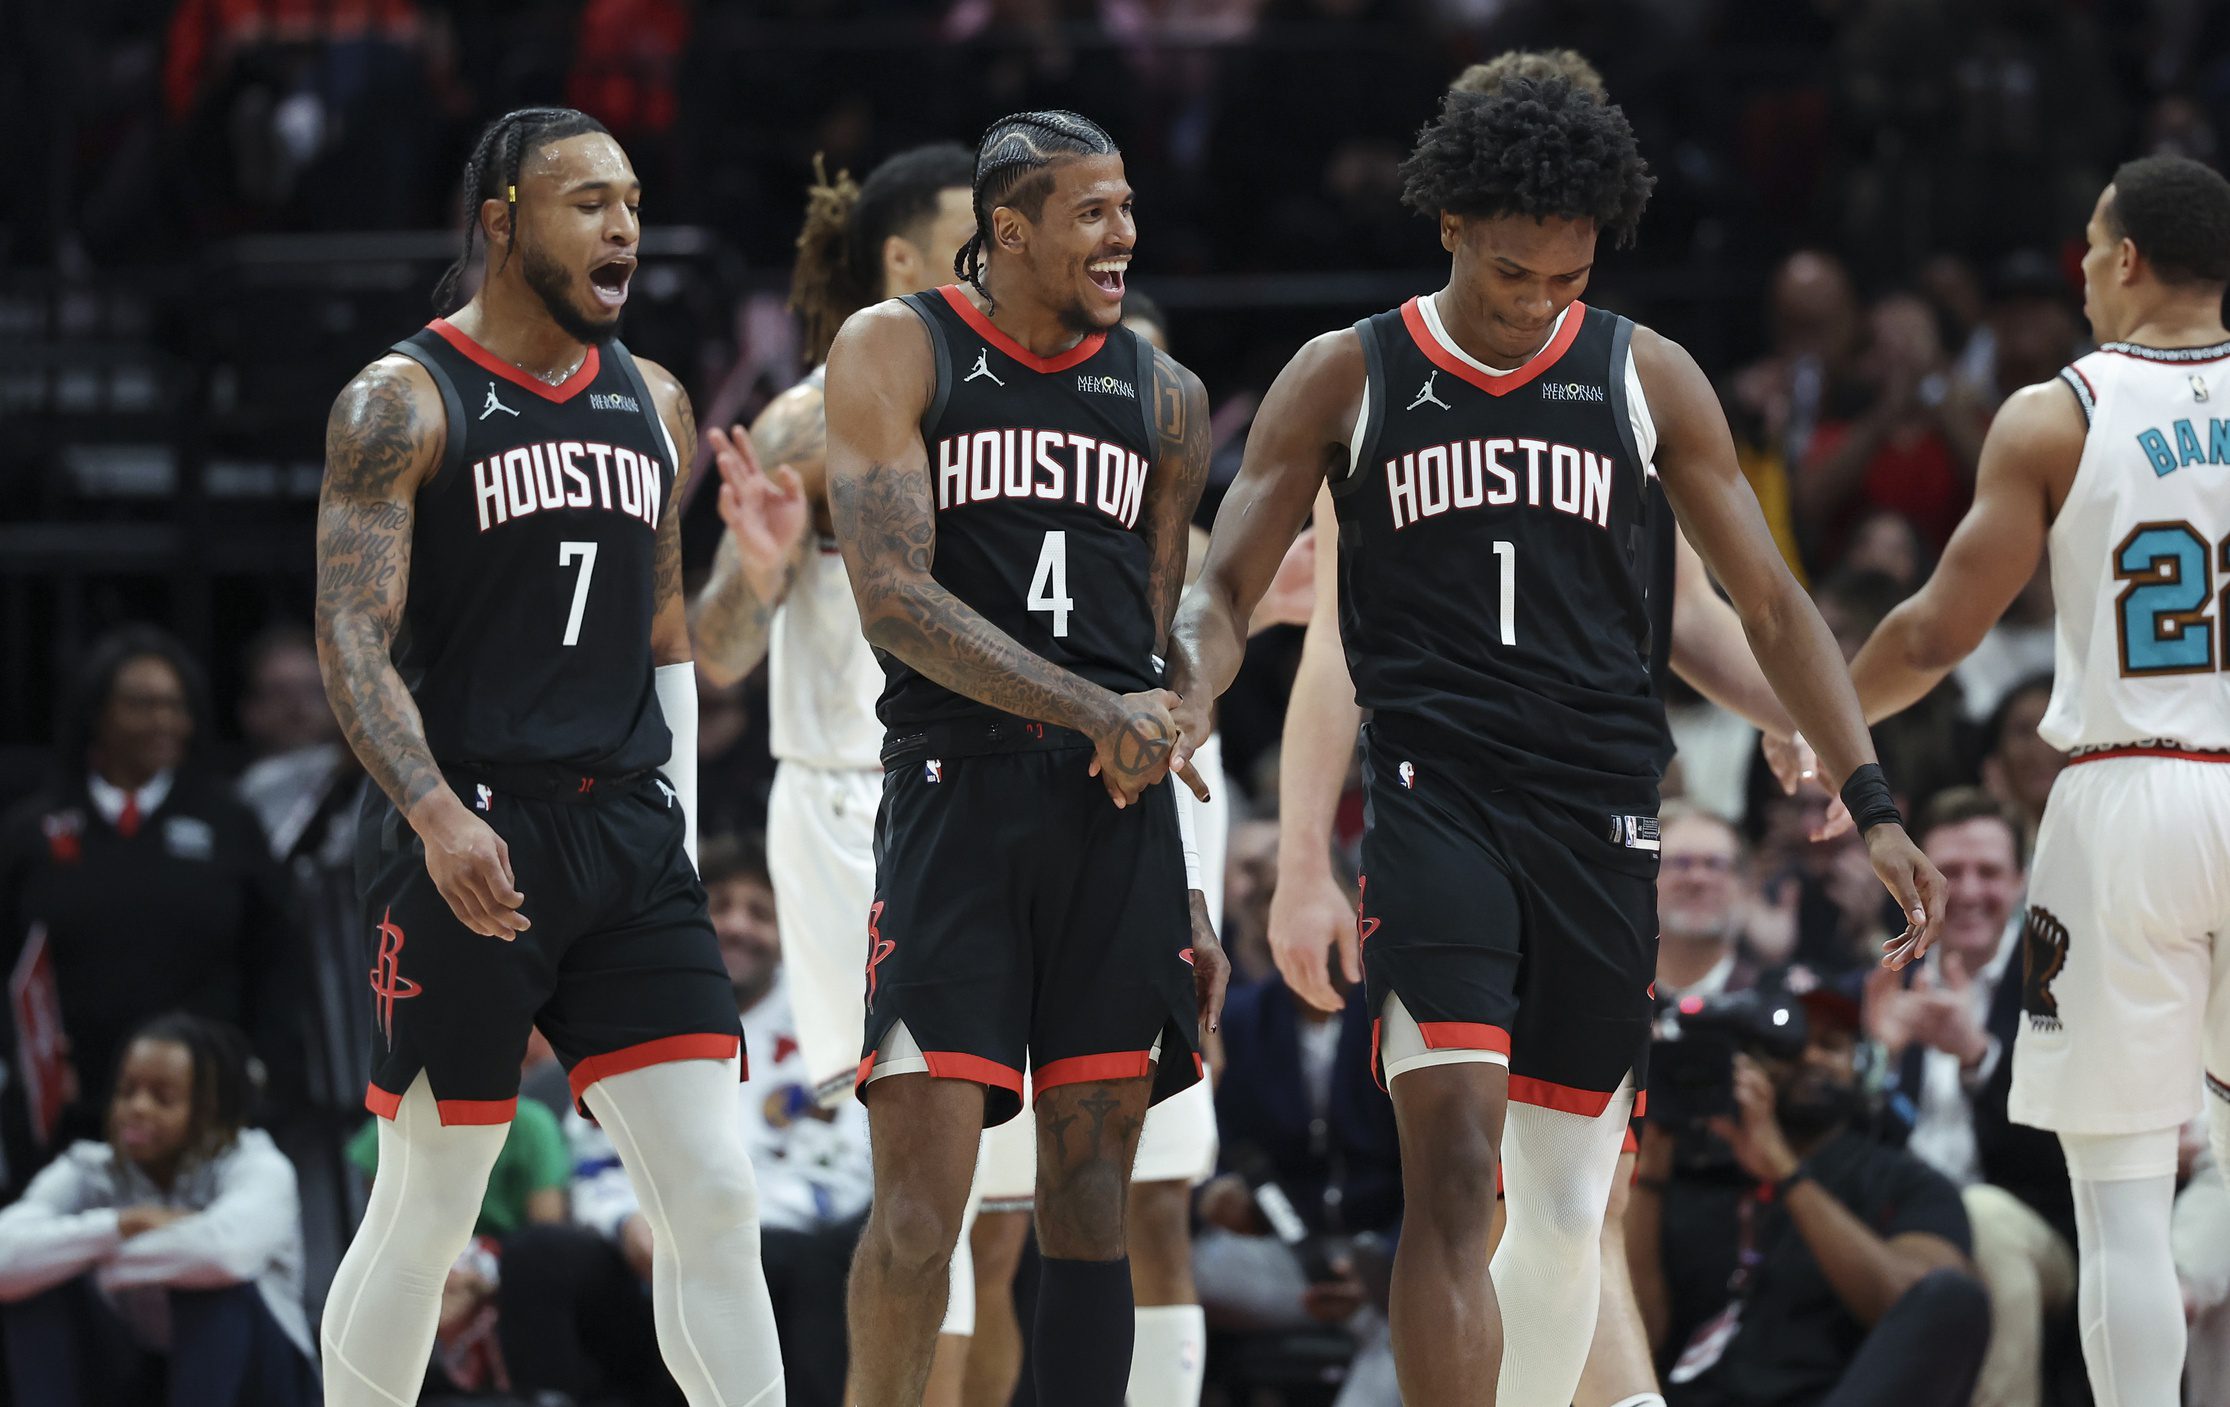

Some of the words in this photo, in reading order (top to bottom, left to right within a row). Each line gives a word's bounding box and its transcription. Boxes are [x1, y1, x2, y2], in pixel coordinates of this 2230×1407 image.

[1077, 375, 1135, 392] MEMORIAL
[1077, 382, 1135, 399] HERMANN
[1542, 382, 1603, 396] MEMORIAL
[1542, 389, 1604, 402] HERMANN
[472, 441, 663, 533] HOUSTON
[938, 427, 1151, 531] HOUSTON
[1384, 437, 1615, 531] HOUSTON
[559, 541, 598, 646] 7
[1027, 530, 1074, 638] 4
[1493, 541, 1517, 646] 1
[2112, 519, 2230, 679] 2
